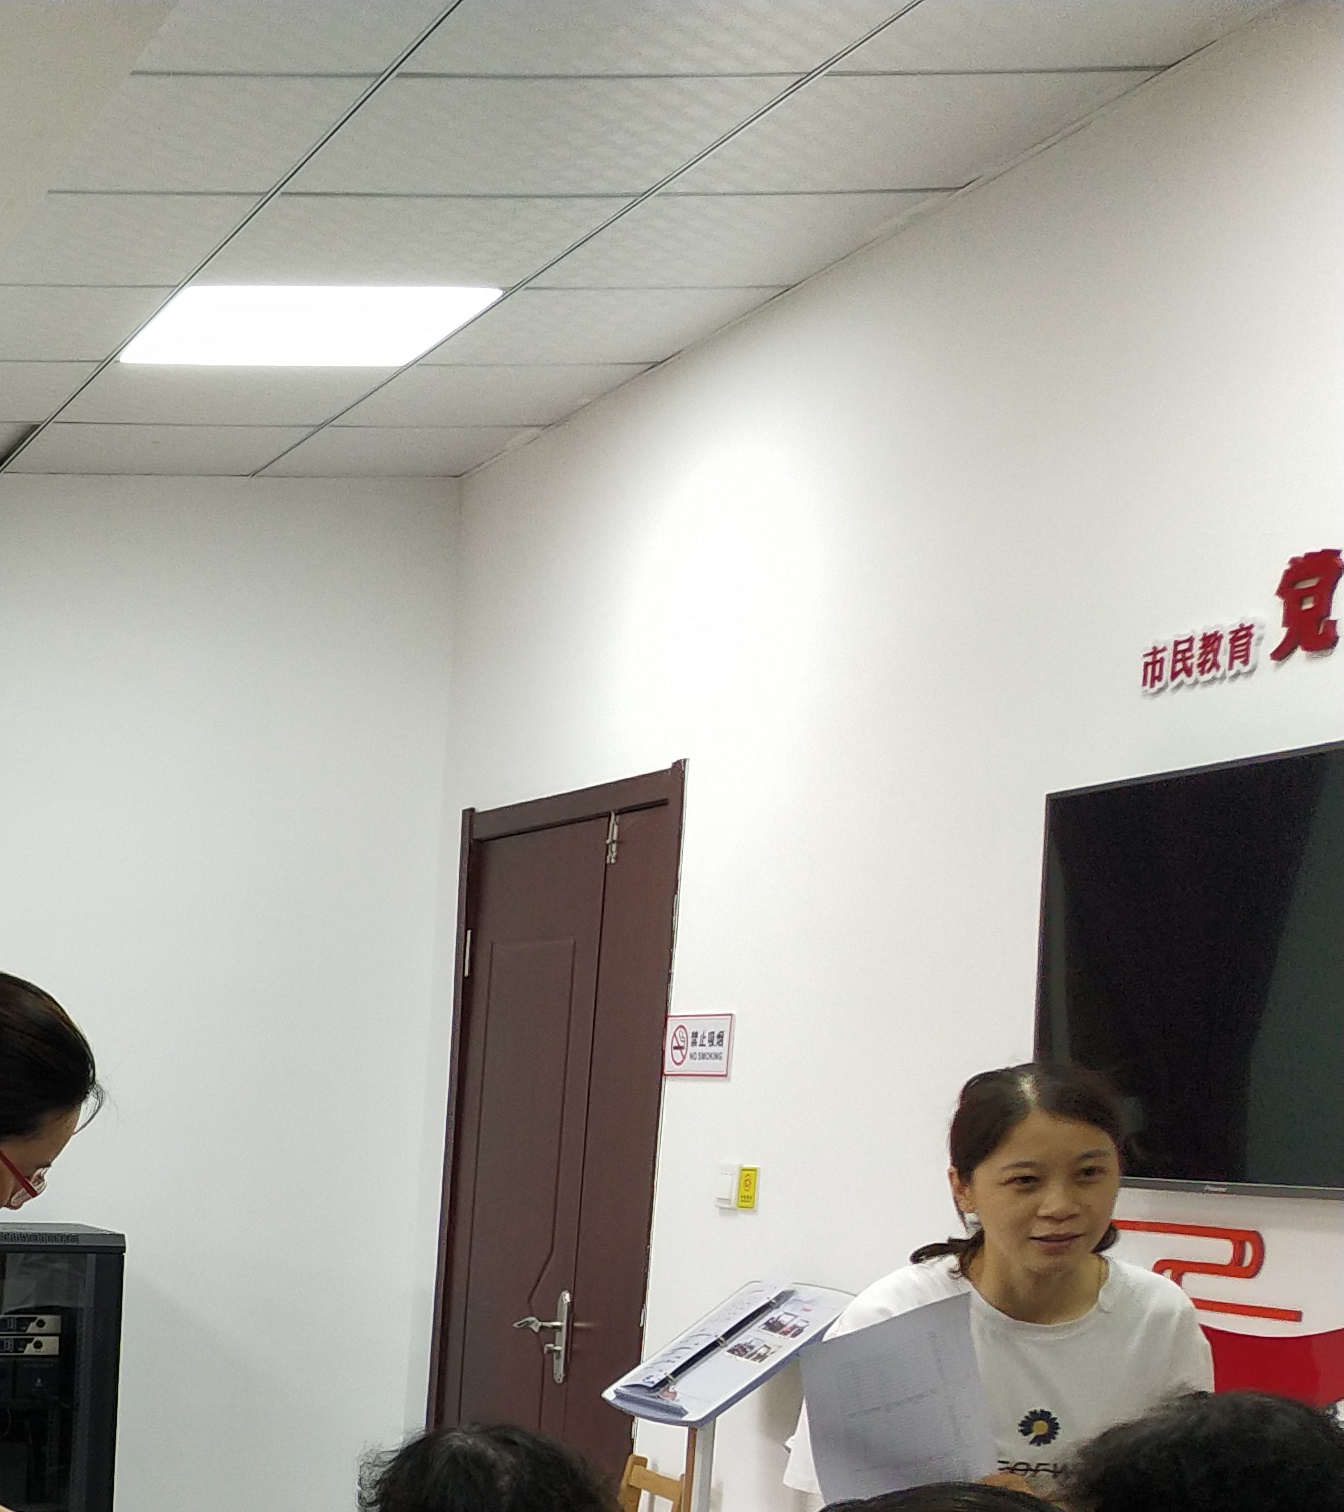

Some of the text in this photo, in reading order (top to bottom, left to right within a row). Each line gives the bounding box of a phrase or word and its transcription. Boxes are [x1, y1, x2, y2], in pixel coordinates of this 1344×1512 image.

[1141, 622, 1256, 689] 市民教育
[690, 1030, 725, 1047] 禁止吸烟
[689, 1052, 723, 1060] NO SMOKING
